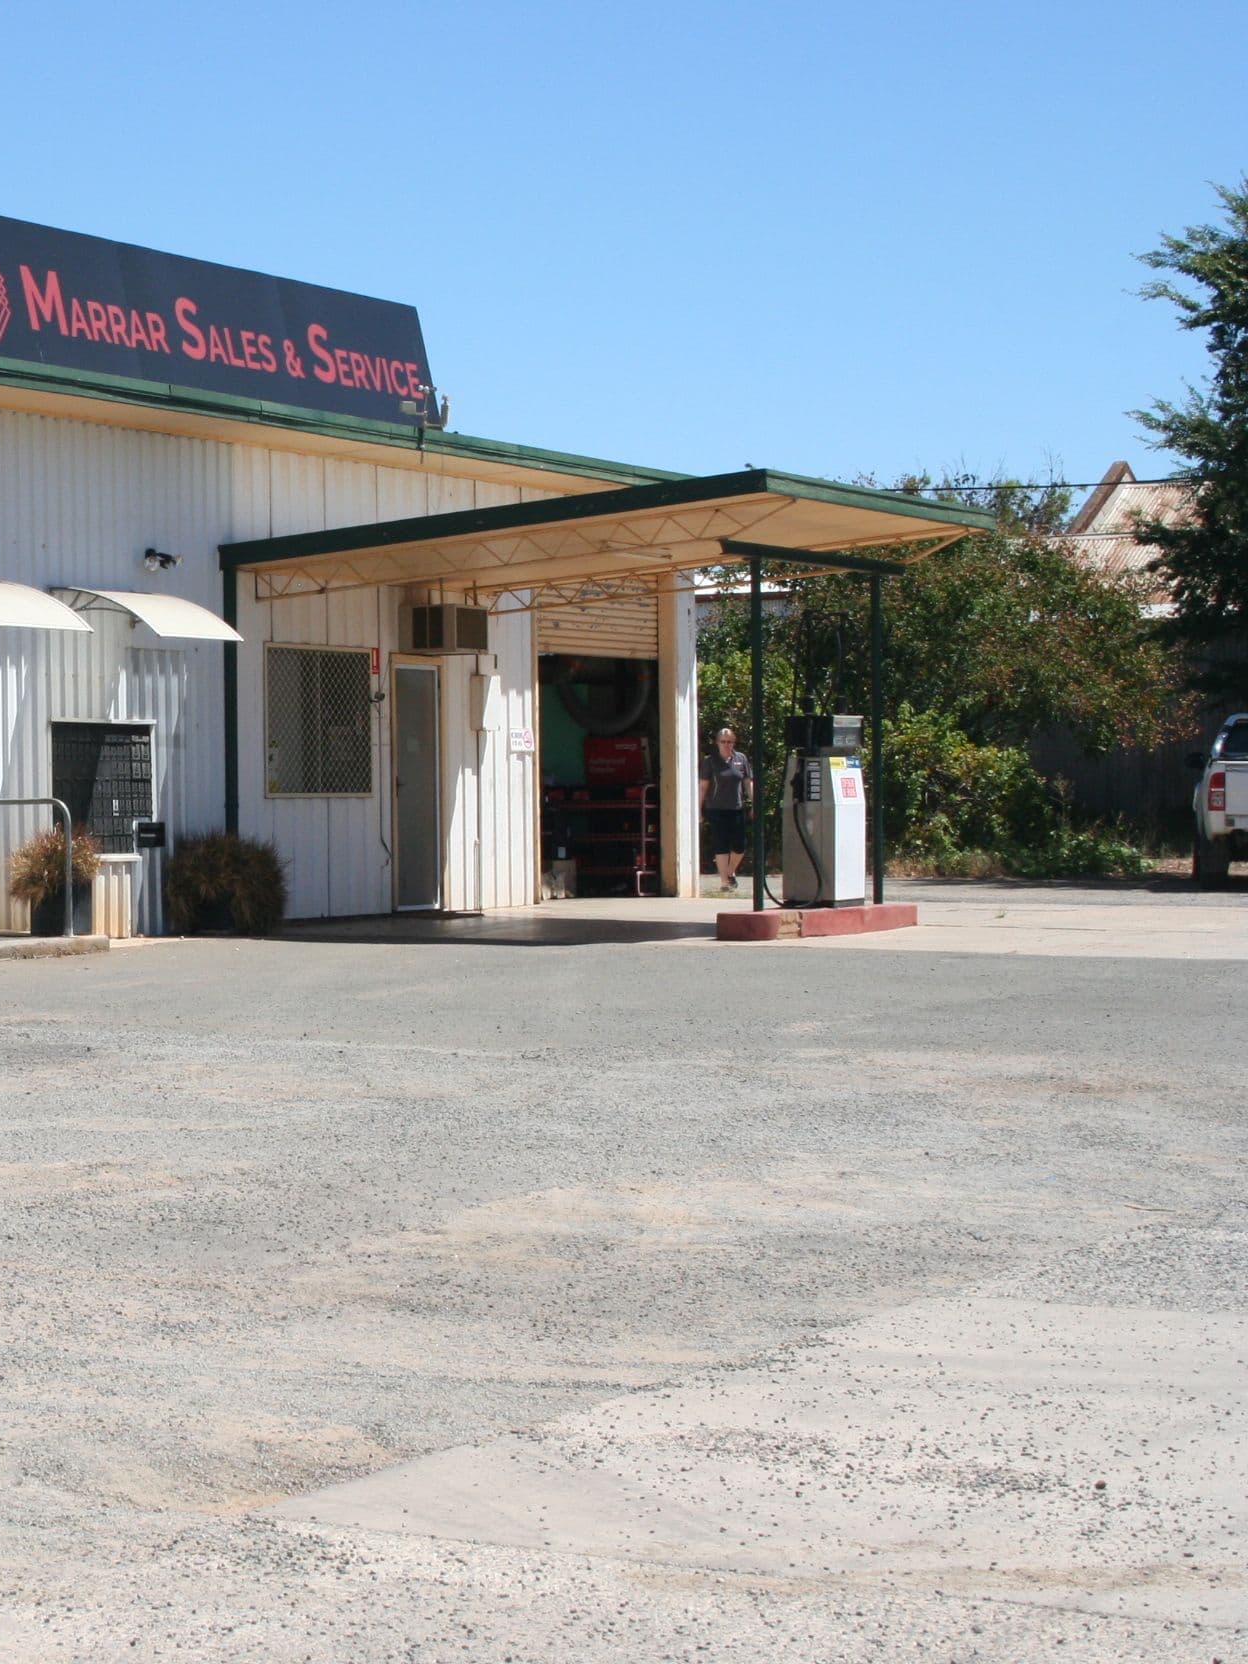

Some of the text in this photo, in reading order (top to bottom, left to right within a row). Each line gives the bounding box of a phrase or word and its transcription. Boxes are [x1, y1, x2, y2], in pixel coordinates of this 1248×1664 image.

[19, 264, 424, 400] MARRAR SALES & SERVICE
